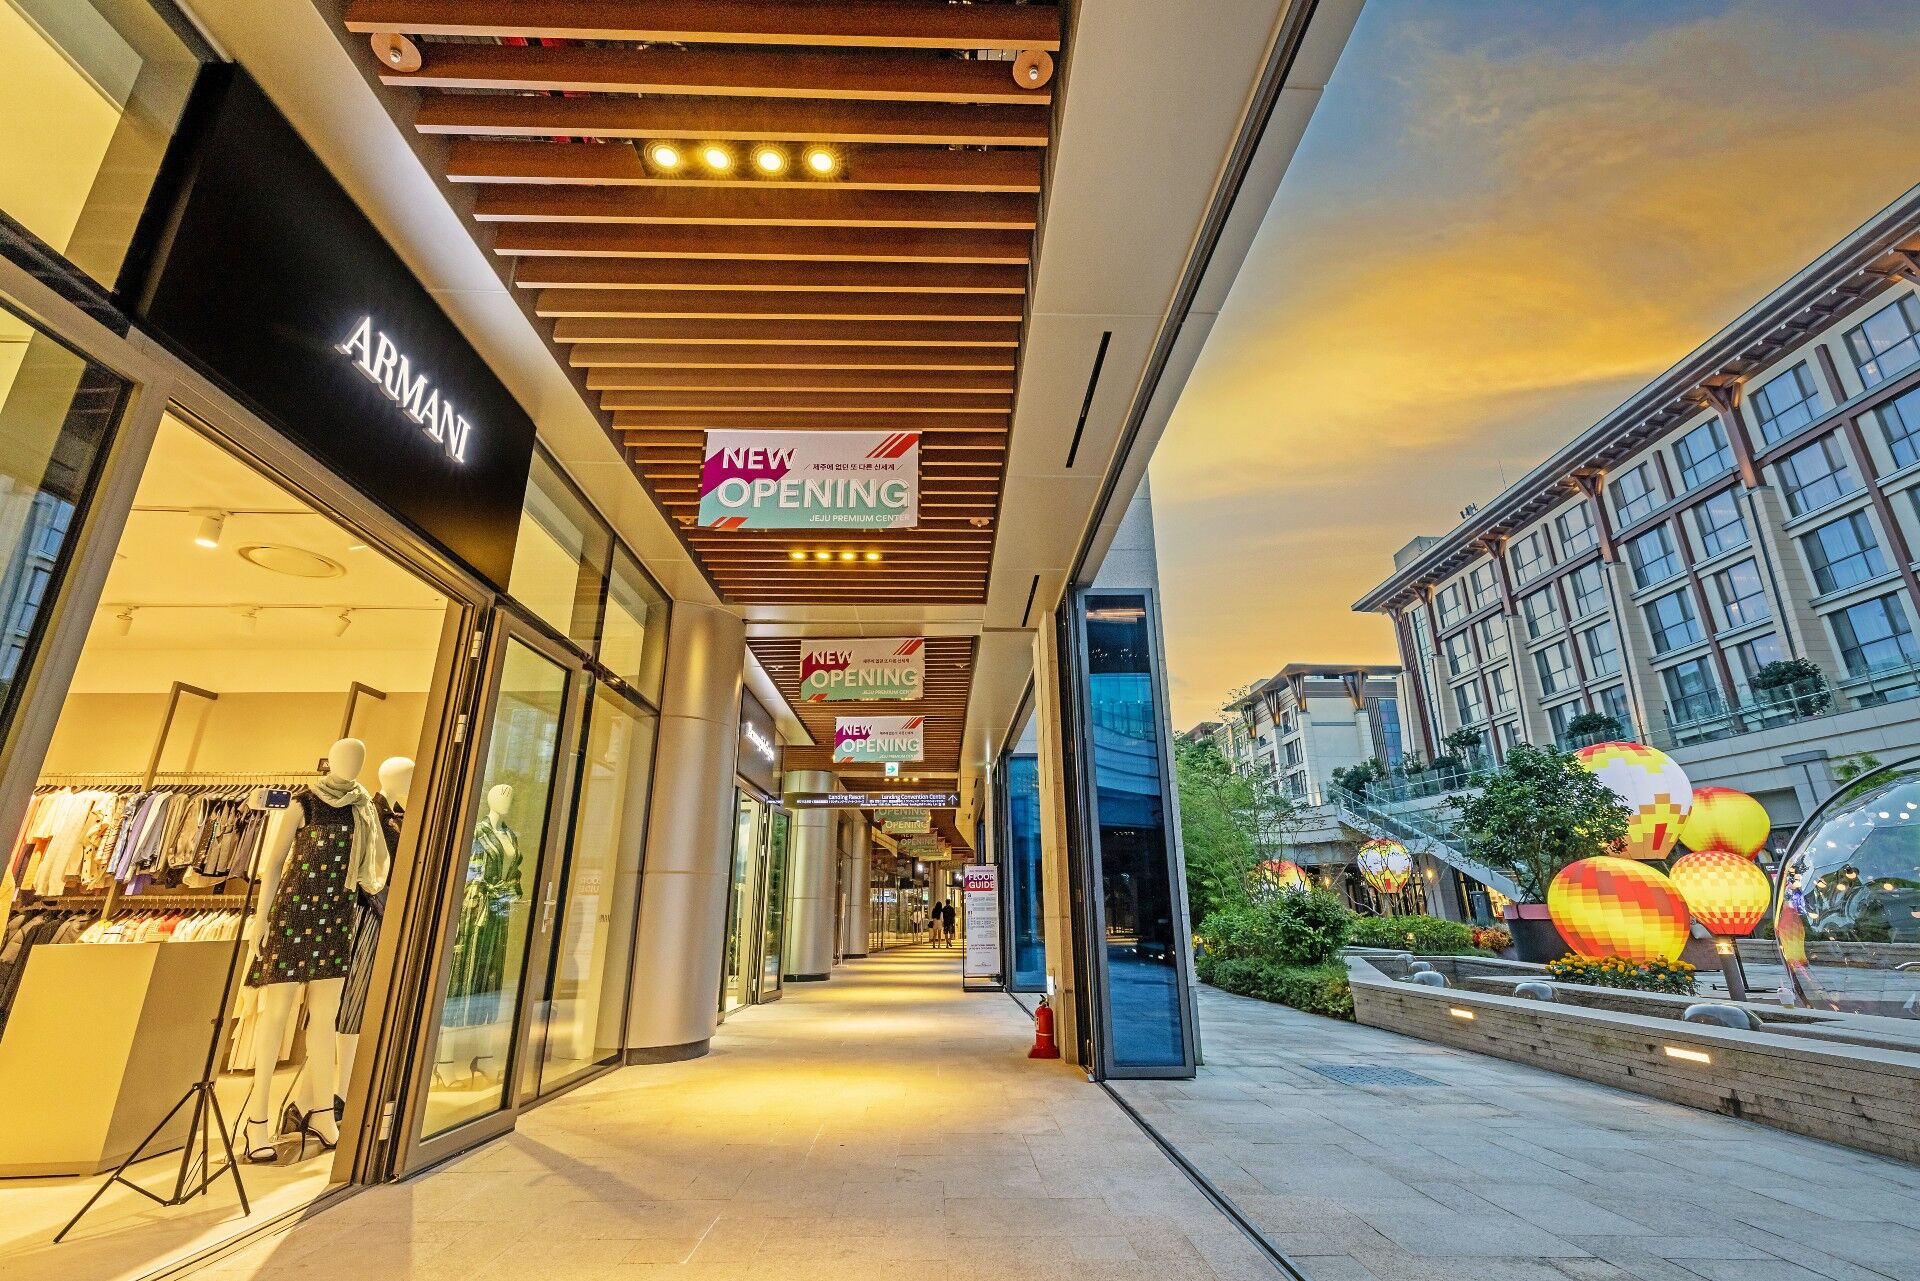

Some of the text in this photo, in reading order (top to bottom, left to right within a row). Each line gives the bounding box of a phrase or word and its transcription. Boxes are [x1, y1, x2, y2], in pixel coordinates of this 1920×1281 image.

[336, 316, 471, 463] ARMANI
[722, 447, 798, 470] NEW
[812, 463, 834, 471] 제주에
[850, 463, 858, 471] 또
[858, 463, 873, 471] 다른
[874, 463, 895, 471] 신세계
[717, 477, 910, 509] OPENING
[809, 514, 831, 522] JEJU
[832, 514, 874, 522] PREMIUM
[812, 650, 854, 665] NEW
[810, 668, 918, 688] OPENING
[842, 725, 873, 736] NEW
[841, 738, 919, 752] OPENING
[885, 821, 928, 829] OPENING
[968, 873, 995, 881] FLOOR
[968, 881, 995, 889] GUIDE
